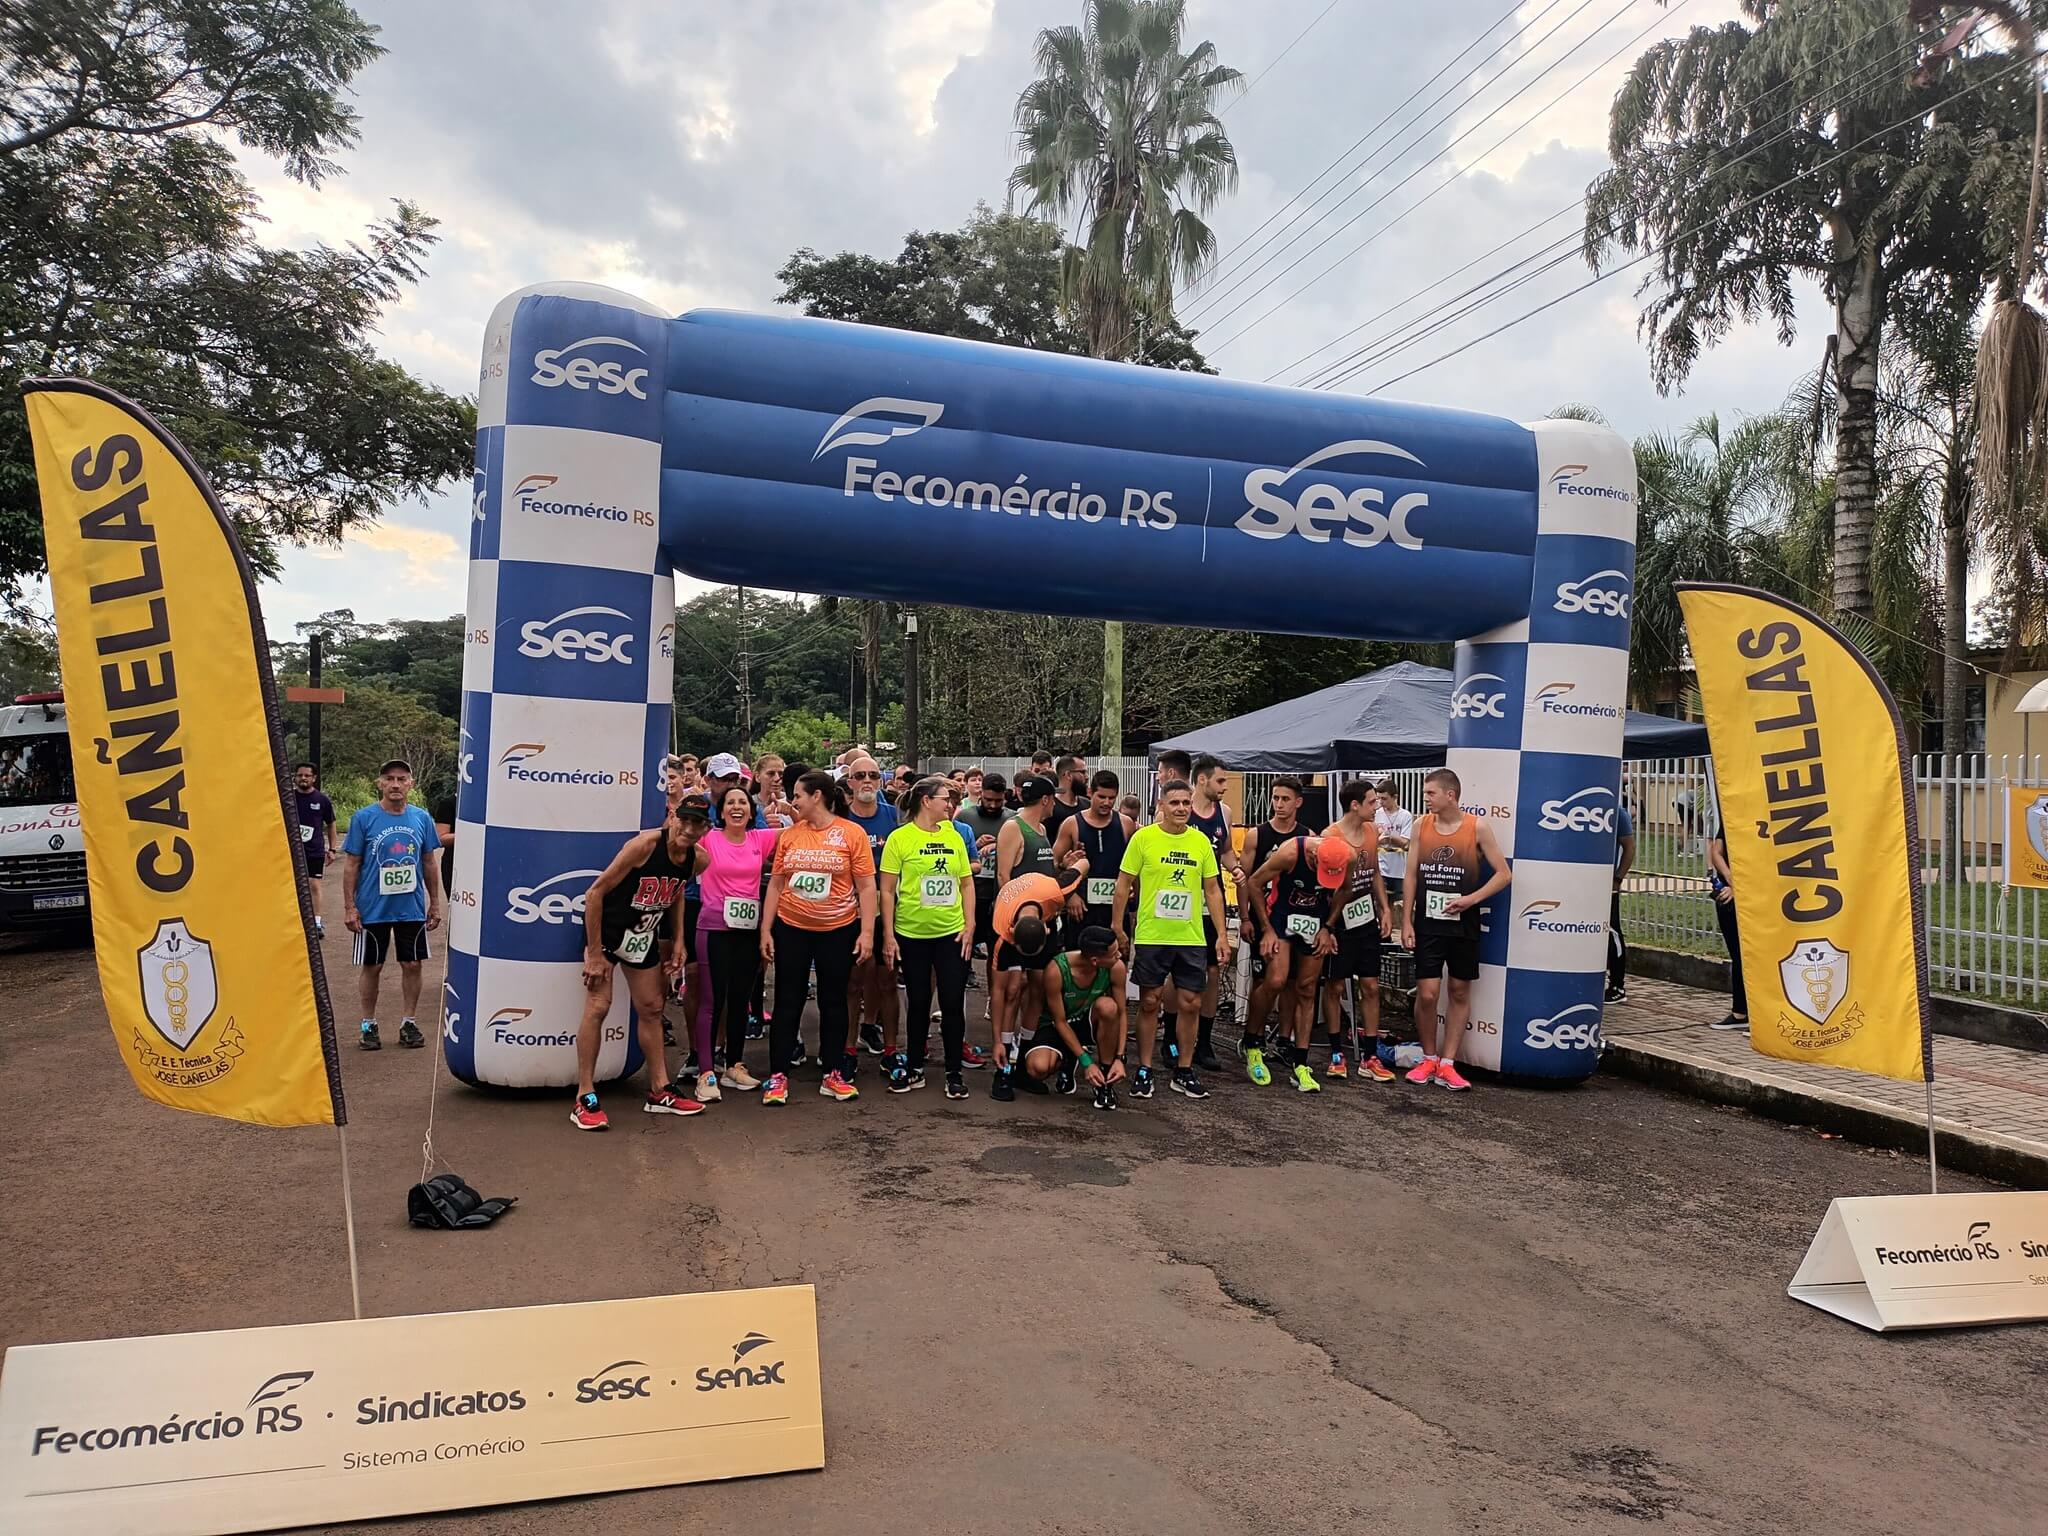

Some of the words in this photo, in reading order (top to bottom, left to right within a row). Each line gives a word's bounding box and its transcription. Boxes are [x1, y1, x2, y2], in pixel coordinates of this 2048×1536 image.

[530, 348, 648, 400] Sesc
[844, 456, 1107, 524] Fecomércio
[1121, 487, 1178, 531] RS
[1557, 482, 1629, 502] Fecomércio
[520, 496, 629, 522] Fecomércio
[633, 509, 655, 527] RS
[1234, 467, 1430, 551] Sesc
[1553, 581, 1628, 619] Sesc
[474, 629, 490, 645] RS
[517, 621, 634, 665] Sesc
[71, 433, 195, 893] CAÑELLAS
[1543, 700, 1617, 718] Fecomércio
[507, 765, 614, 786] Fecomércio
[618, 770, 639, 786] RS
[1736, 621, 1843, 923] CAÑELLAS
[1491, 805, 1511, 819] RS
[1537, 799, 1614, 834] Sesc
[384, 869, 412, 886] 652
[793, 875, 826, 893] 493
[926, 880, 952, 897] 623
[1092, 882, 1116, 896] 422
[461, 891, 477, 907] RS
[1160, 893, 1188, 910] 427
[729, 902, 756, 920] 586
[1347, 899, 1371, 920] 505
[1292, 917, 1317, 936] 529
[1528, 918, 1601, 934] Fecomércio
[605, 1026, 625, 1042] RS
[1477, 1020, 1498, 1035] RS
[1523, 1018, 1600, 1050] Sesc
[179, 1054, 212, 1069] Técnica
[155, 1070, 178, 1085] JOSÉ
[180, 1060, 230, 1085] CAÑELLAS
[1874, 1243, 1973, 1266] Fecomércio
[1975, 1241, 1999, 1260] RS
[2020, 1239, 2048, 1258] Sin
[31, 1412, 244, 1457] Fecomércio
[256, 1403, 303, 1435] RS
[355, 1386, 527, 1426] Sindicatos
[575, 1372, 651, 1404] Sesc
[695, 1359, 786, 1394] Senac
[342, 1443, 428, 1471] Sistema
[434, 1435, 525, 1465] Comércio
